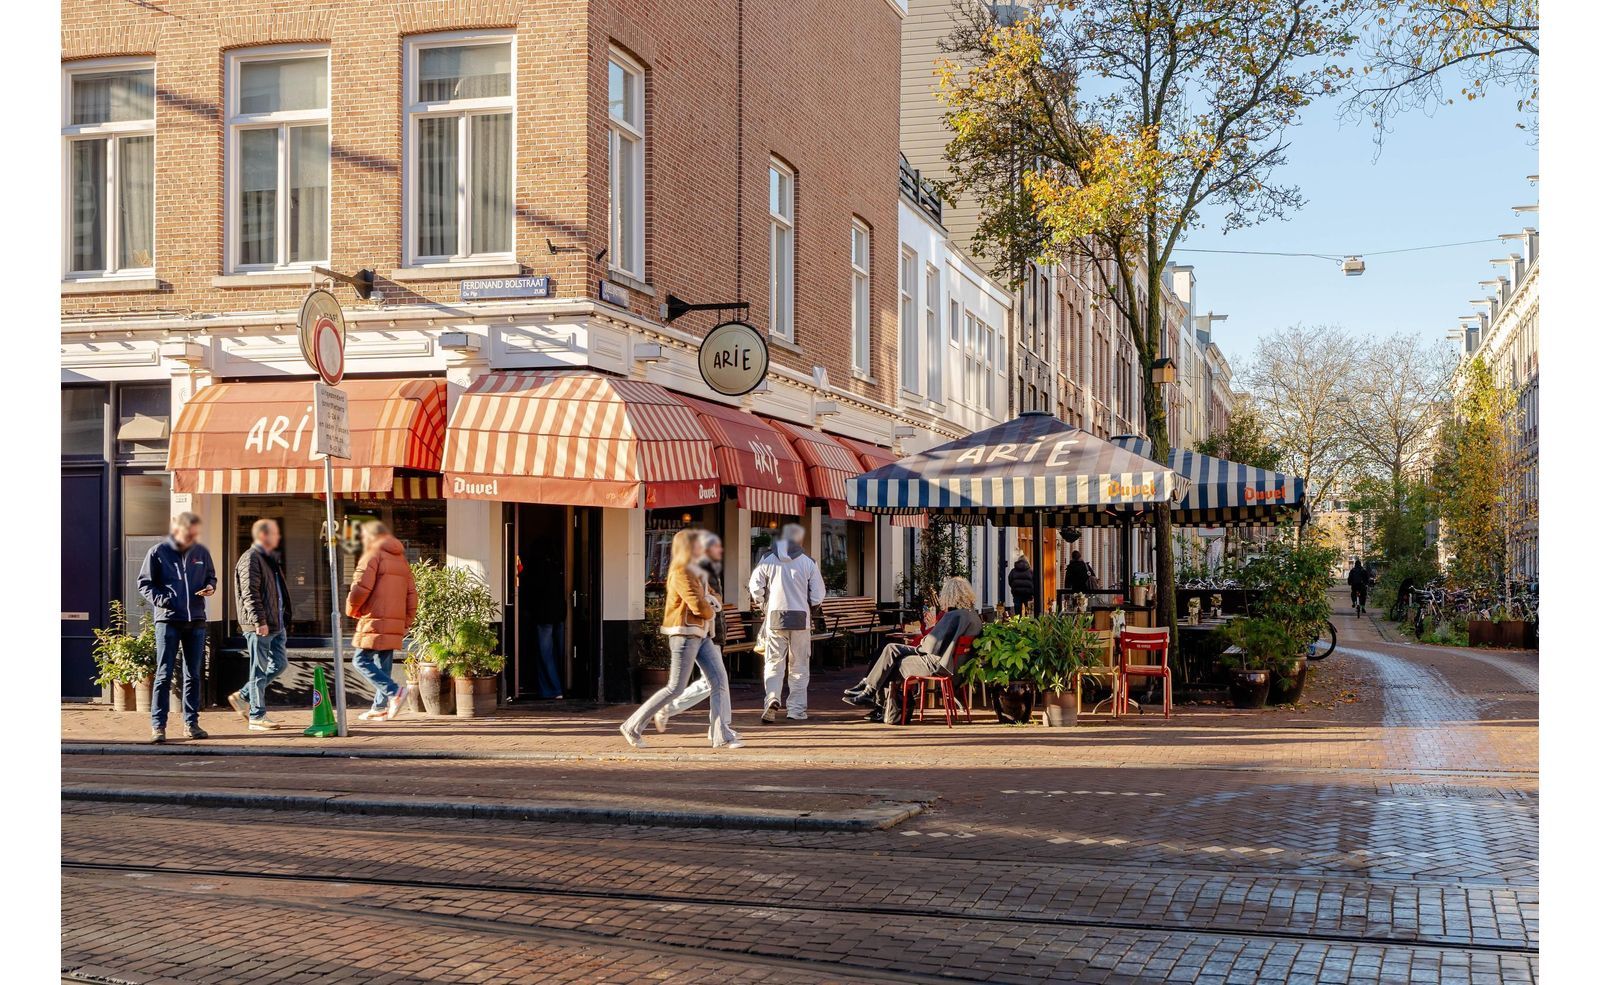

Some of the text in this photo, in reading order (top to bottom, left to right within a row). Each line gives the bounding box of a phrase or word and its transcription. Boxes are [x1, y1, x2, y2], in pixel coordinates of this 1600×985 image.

[463, 279, 544, 290] FERDINAND BOLSTRAAT
[453, 476, 498, 496] Duvel
[698, 483, 717, 500] Duvel
[1107, 479, 1157, 497] Duvel
[1244, 485, 1287, 501] Duvel
